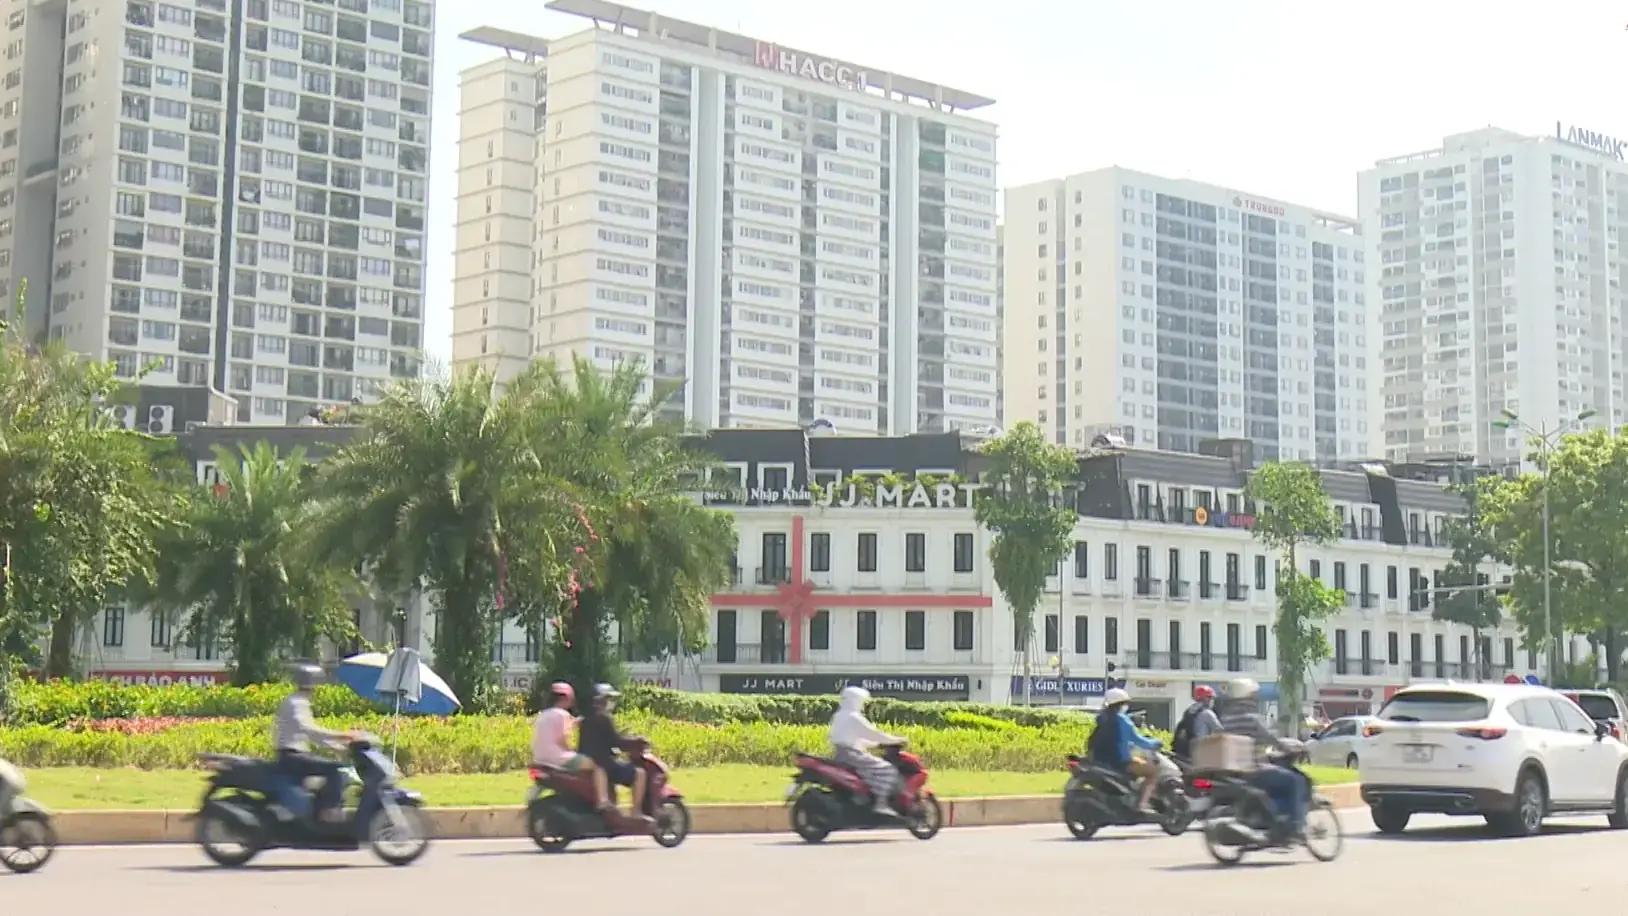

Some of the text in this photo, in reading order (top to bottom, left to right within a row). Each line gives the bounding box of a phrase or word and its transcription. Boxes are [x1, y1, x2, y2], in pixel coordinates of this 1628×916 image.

[877, 480, 983, 508] MART
[742, 679, 804, 689] JJ MART
[861, 678, 884, 690] Siêu
[887, 679, 904, 692] Thị
[907, 679, 934, 692] Nhập
[936, 677, 964, 690] Khẩu
